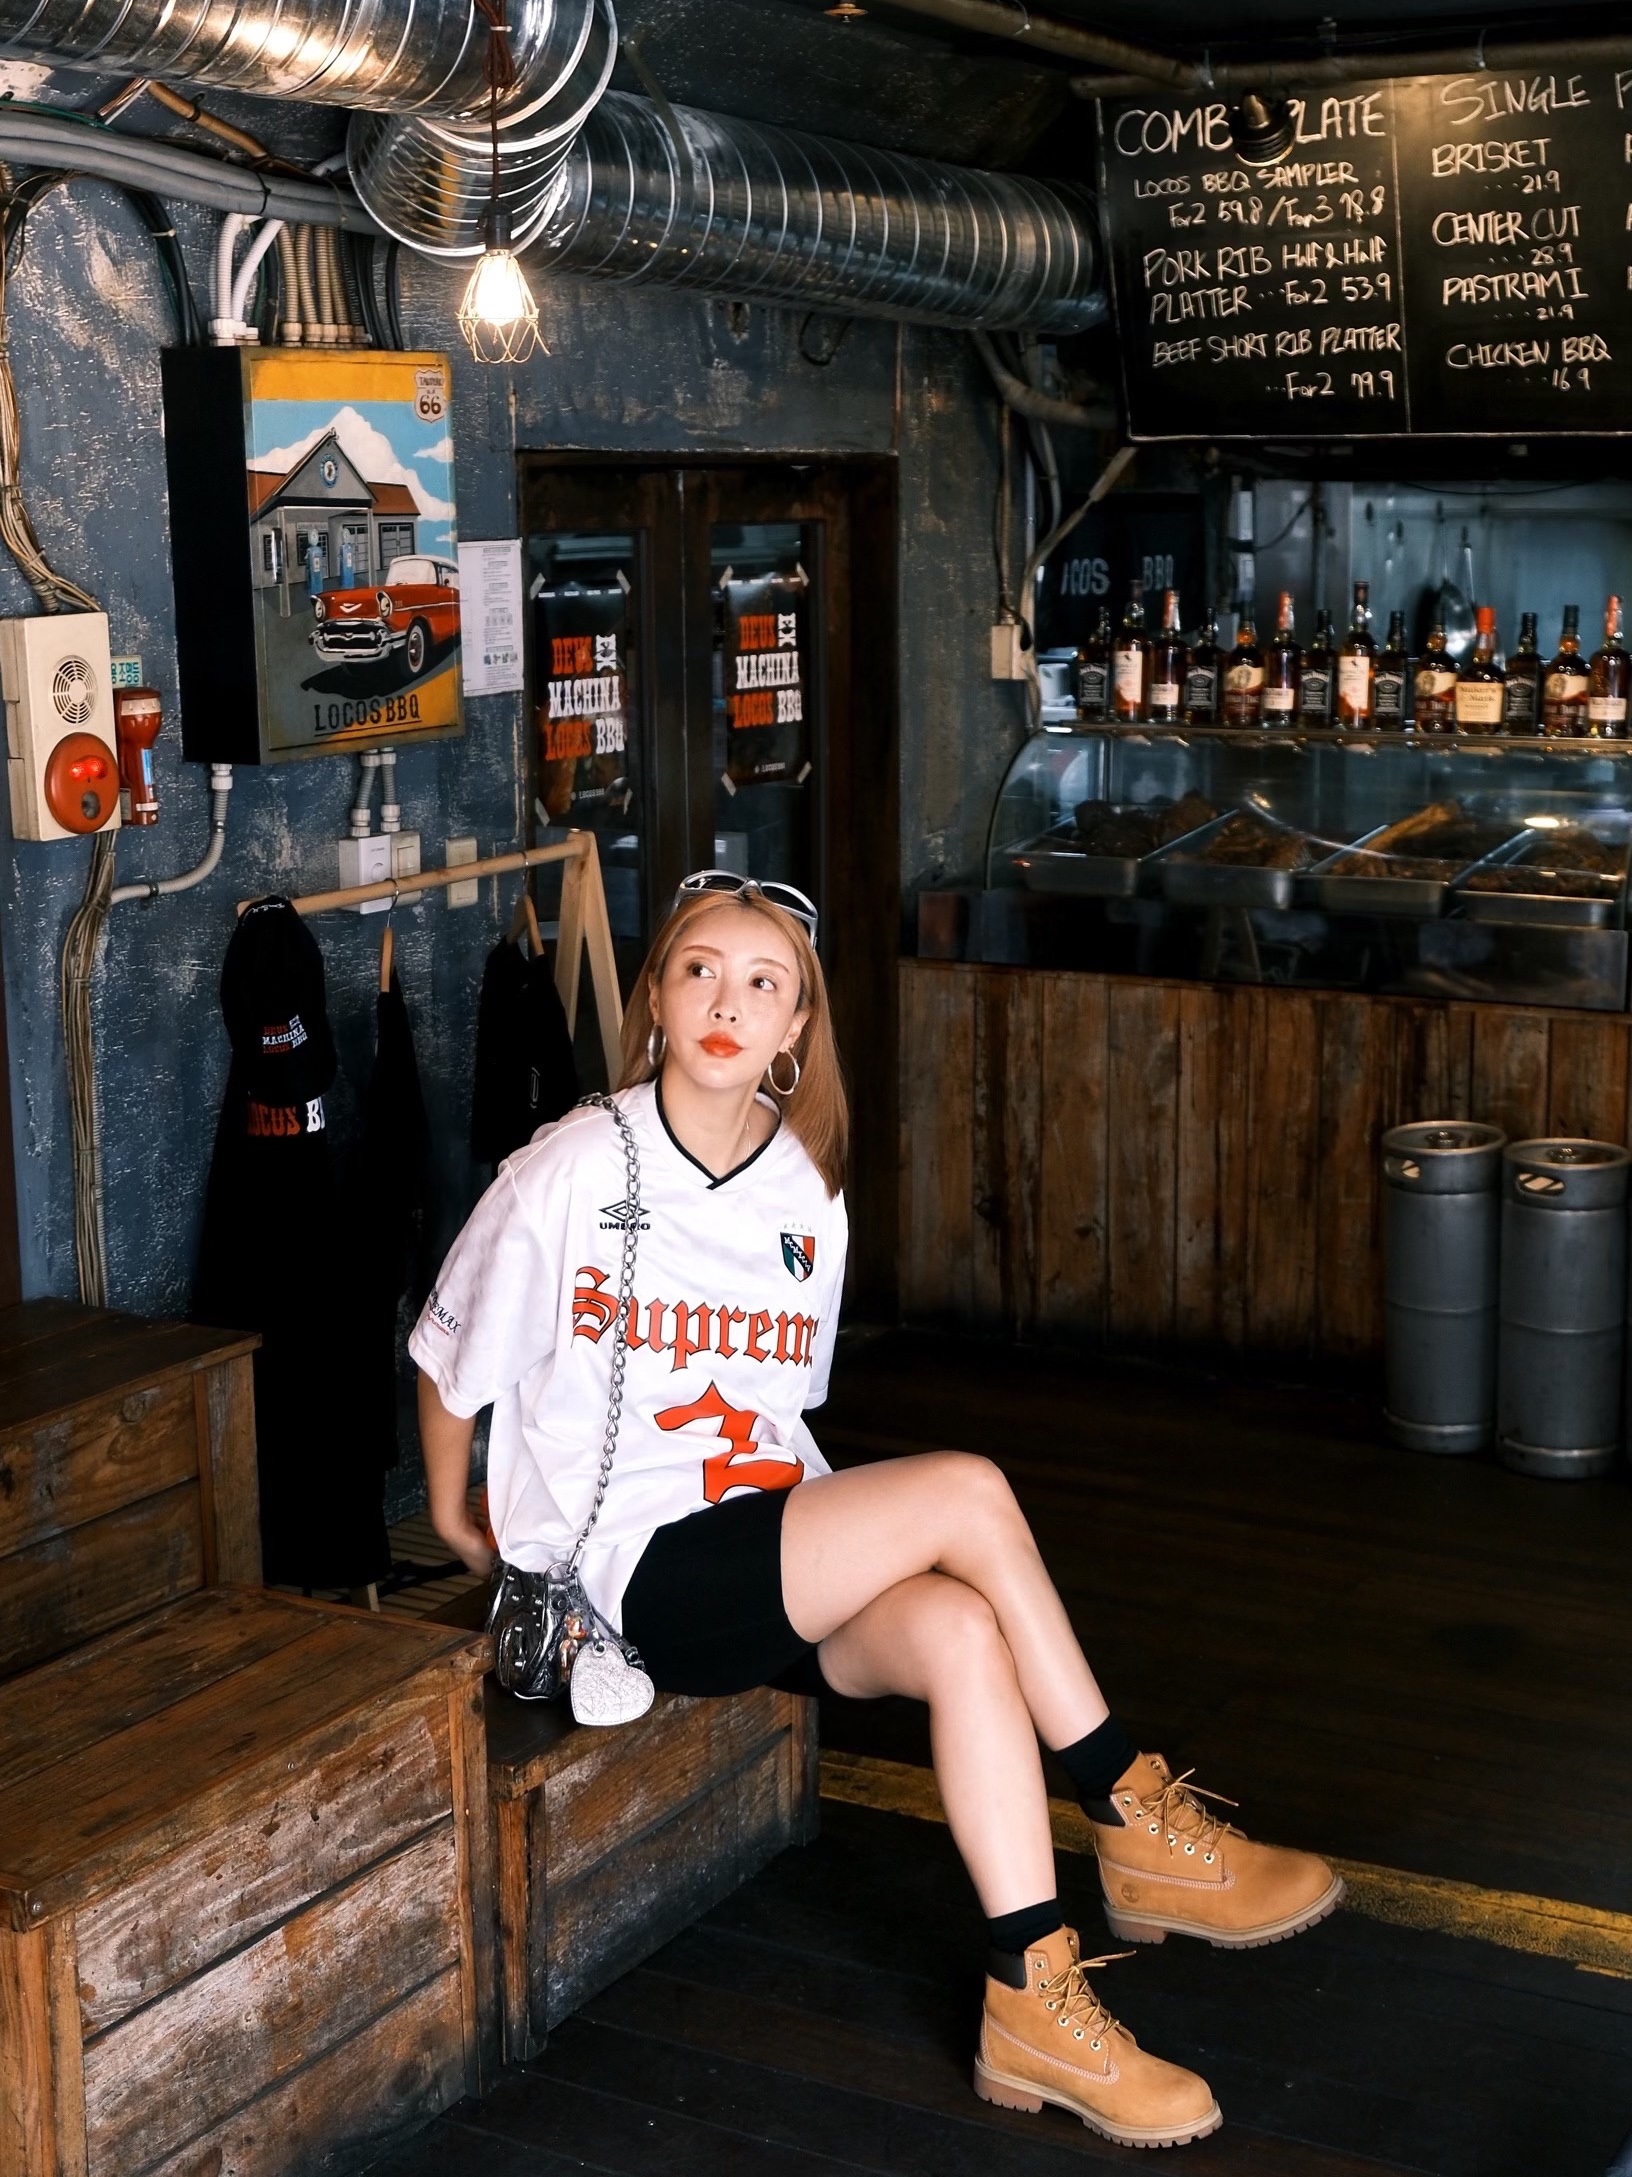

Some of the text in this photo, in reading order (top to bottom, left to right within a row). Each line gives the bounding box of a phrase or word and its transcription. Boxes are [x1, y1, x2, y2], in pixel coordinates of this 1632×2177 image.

[1440, 74, 1592, 125] SINGLE
[1115, 103, 1234, 155] COMB
[1432, 138, 1552, 177] BRISKET
[1134, 161, 1360, 199] LOCOS BBQ SAMPLER
[1521, 170, 1561, 194] 21.9
[1432, 210, 1530, 247] CENTER
[1531, 205, 1582, 241] CUT
[1143, 248, 1212, 288] PORK
[1217, 246, 1272, 281] RIB
[1442, 267, 1590, 305] PASTRAMI
[1150, 285, 1252, 325] PLATTER
[1340, 272, 1392, 301] 53.9
[1152, 322, 1402, 369] BEEF SHORT RIB PLATTER
[1445, 333, 1613, 369] CHICKEN BBQ
[419, 394, 442, 415] 66
[735, 651, 800, 690] MACHINA
[547, 675, 622, 719] MACHINA
[262, 1023, 305, 1046] MACHINA
[571, 1265, 820, 1373] Suprem
